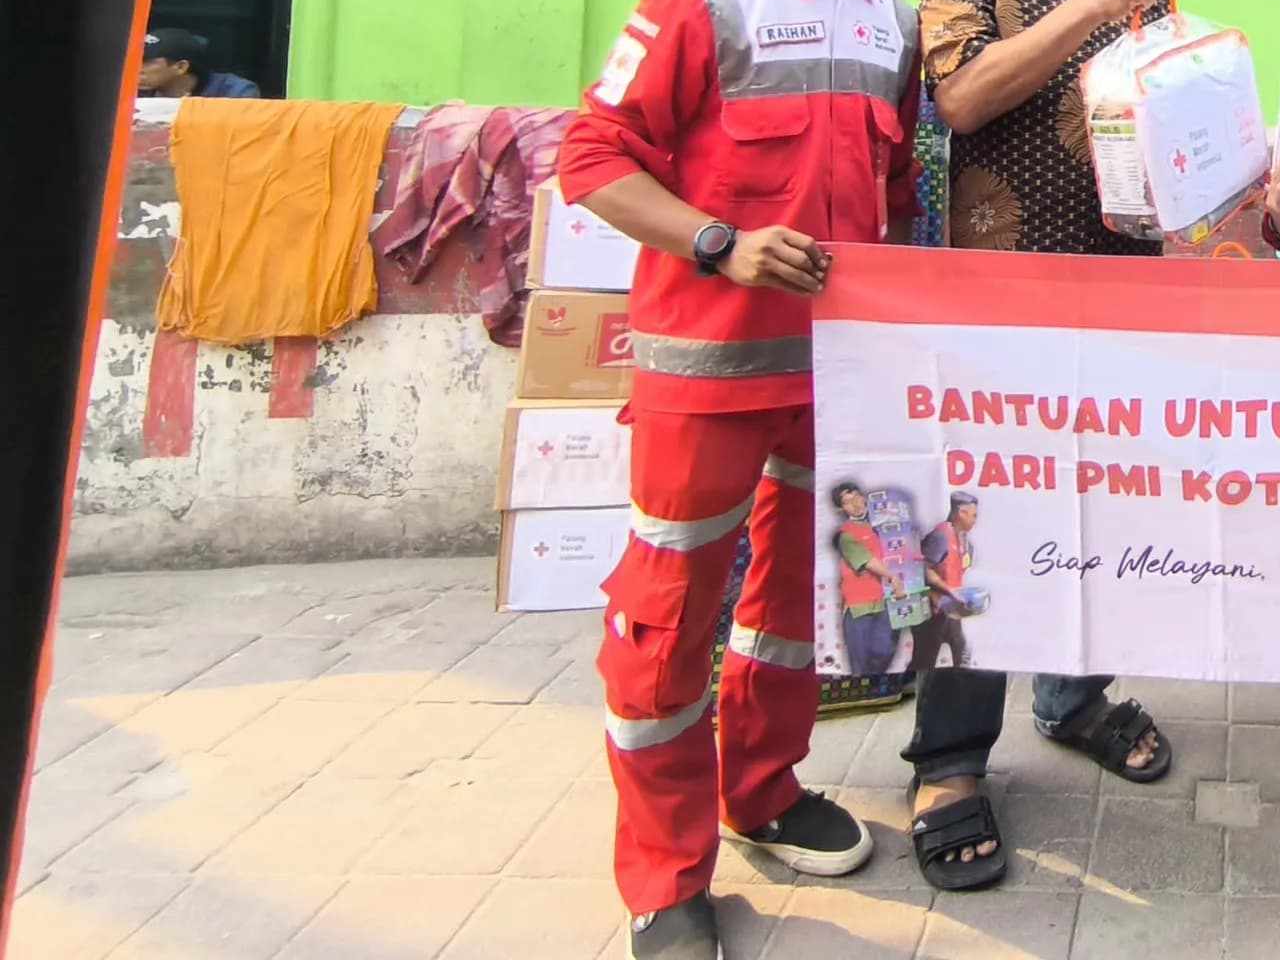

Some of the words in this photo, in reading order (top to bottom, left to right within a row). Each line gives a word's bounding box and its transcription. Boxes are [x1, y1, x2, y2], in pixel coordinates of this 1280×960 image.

[907, 385, 1143, 438] BANTUAN
[946, 450, 1057, 491] DARI
[1077, 461, 1162, 498] PMI
[1030, 541, 1103, 580] Siap
